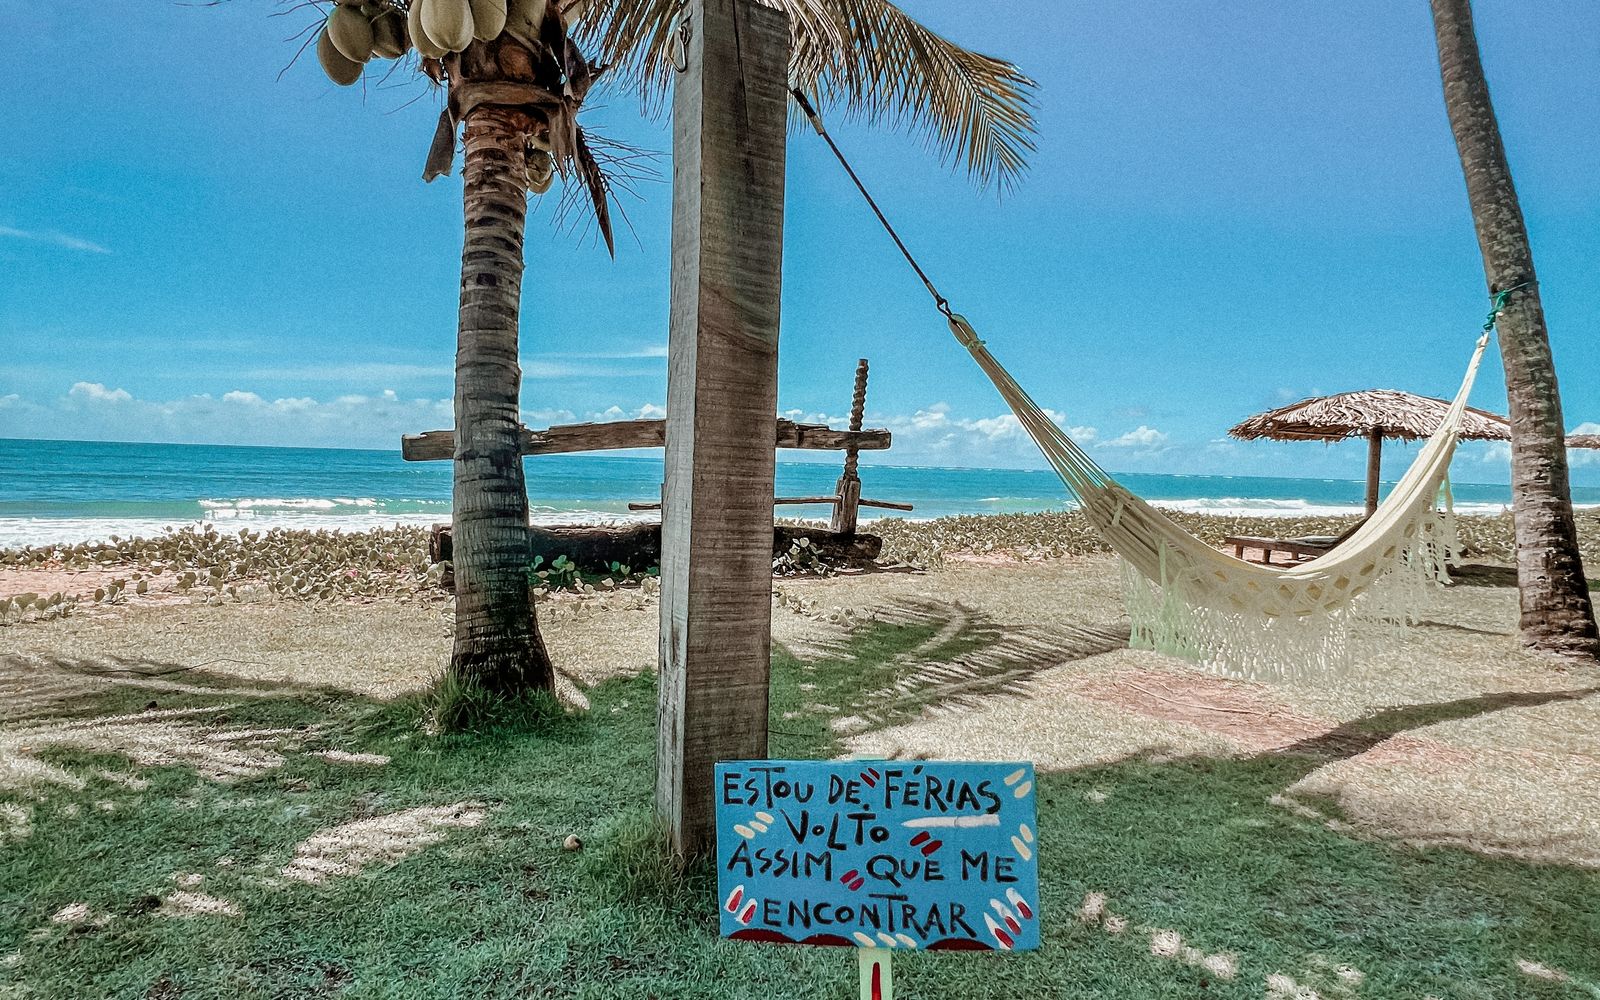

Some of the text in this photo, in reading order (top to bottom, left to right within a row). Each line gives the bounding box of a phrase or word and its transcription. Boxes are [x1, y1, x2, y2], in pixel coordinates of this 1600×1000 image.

[723, 766, 814, 809] ESTOU
[885, 764, 1002, 815] FÉRIAS
[726, 839, 1019, 888] ASSIM QUE ME
[762, 893, 979, 940] ENCONTRAR
